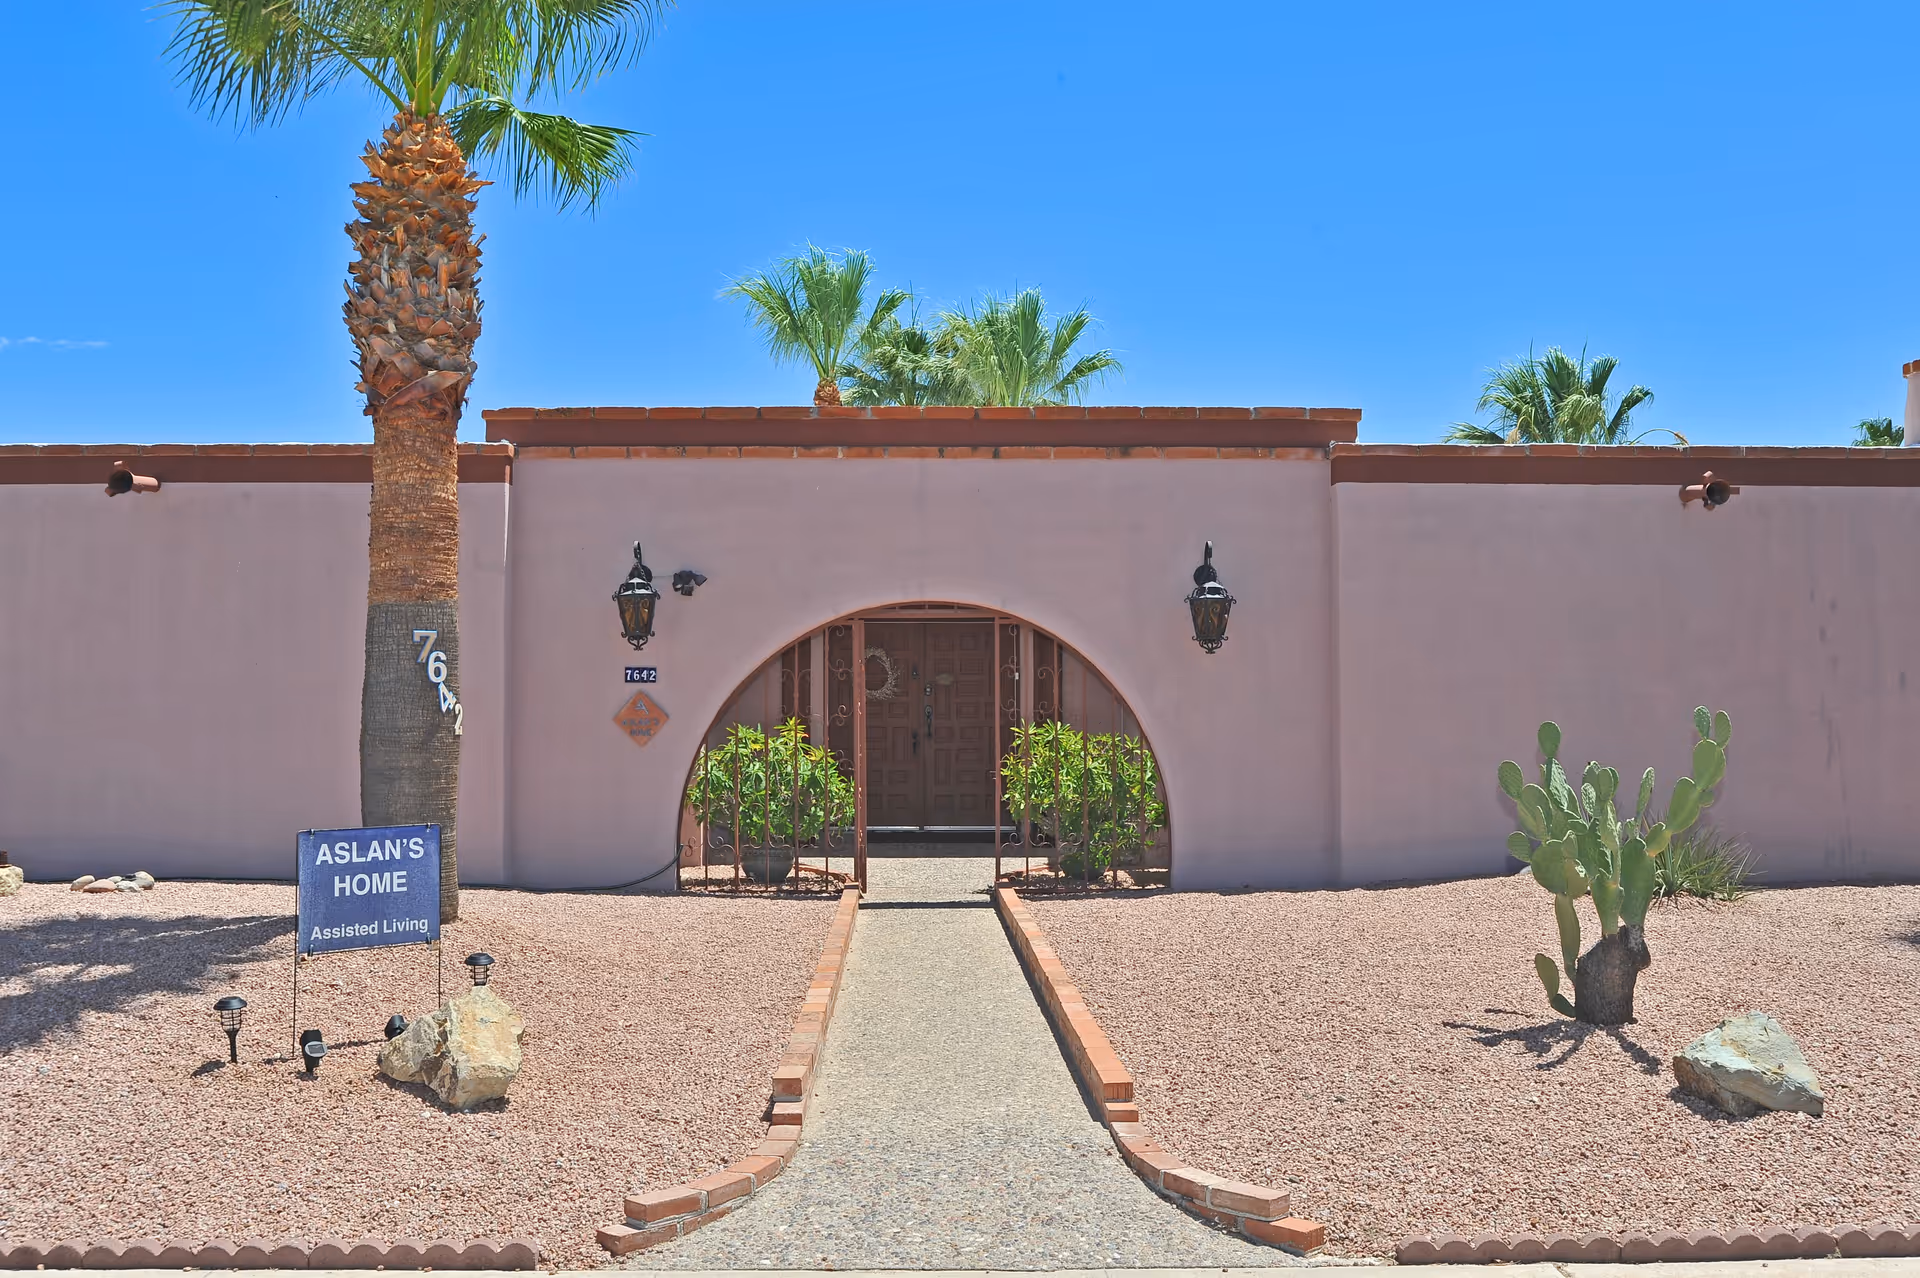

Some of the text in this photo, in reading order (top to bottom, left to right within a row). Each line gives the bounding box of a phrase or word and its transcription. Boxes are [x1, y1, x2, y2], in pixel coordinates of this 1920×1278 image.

[412, 628, 463, 735] 7642
[626, 669, 656, 681] 7642
[315, 837, 424, 865] ASLAN'S
[334, 871, 408, 897] HOME
[310, 917, 428, 940] Assisted Living
